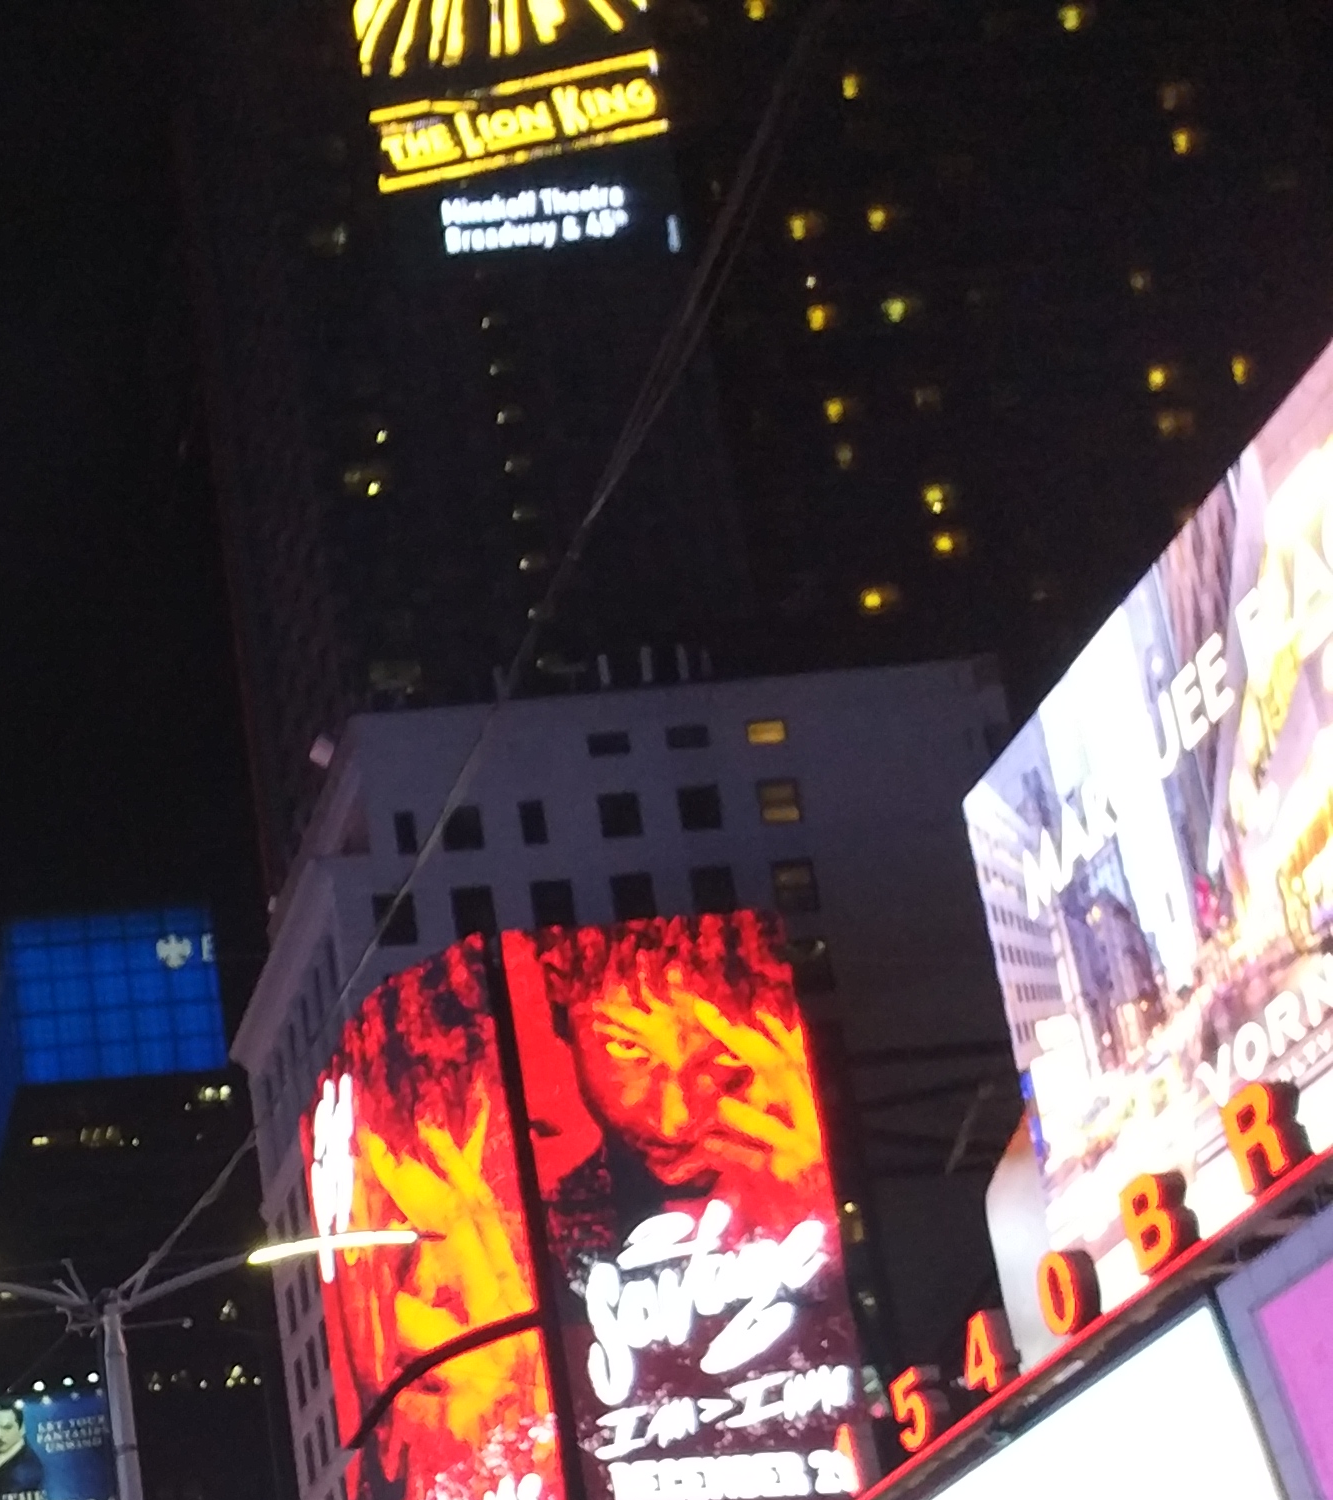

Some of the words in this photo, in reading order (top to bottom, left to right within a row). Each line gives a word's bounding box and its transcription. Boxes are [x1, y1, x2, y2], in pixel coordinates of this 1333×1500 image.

[380, 122, 462, 171] THE
[453, 108, 556, 158] LION
[551, 77, 658, 136] KING
[1022, 631, 1236, 921] MARUEE
